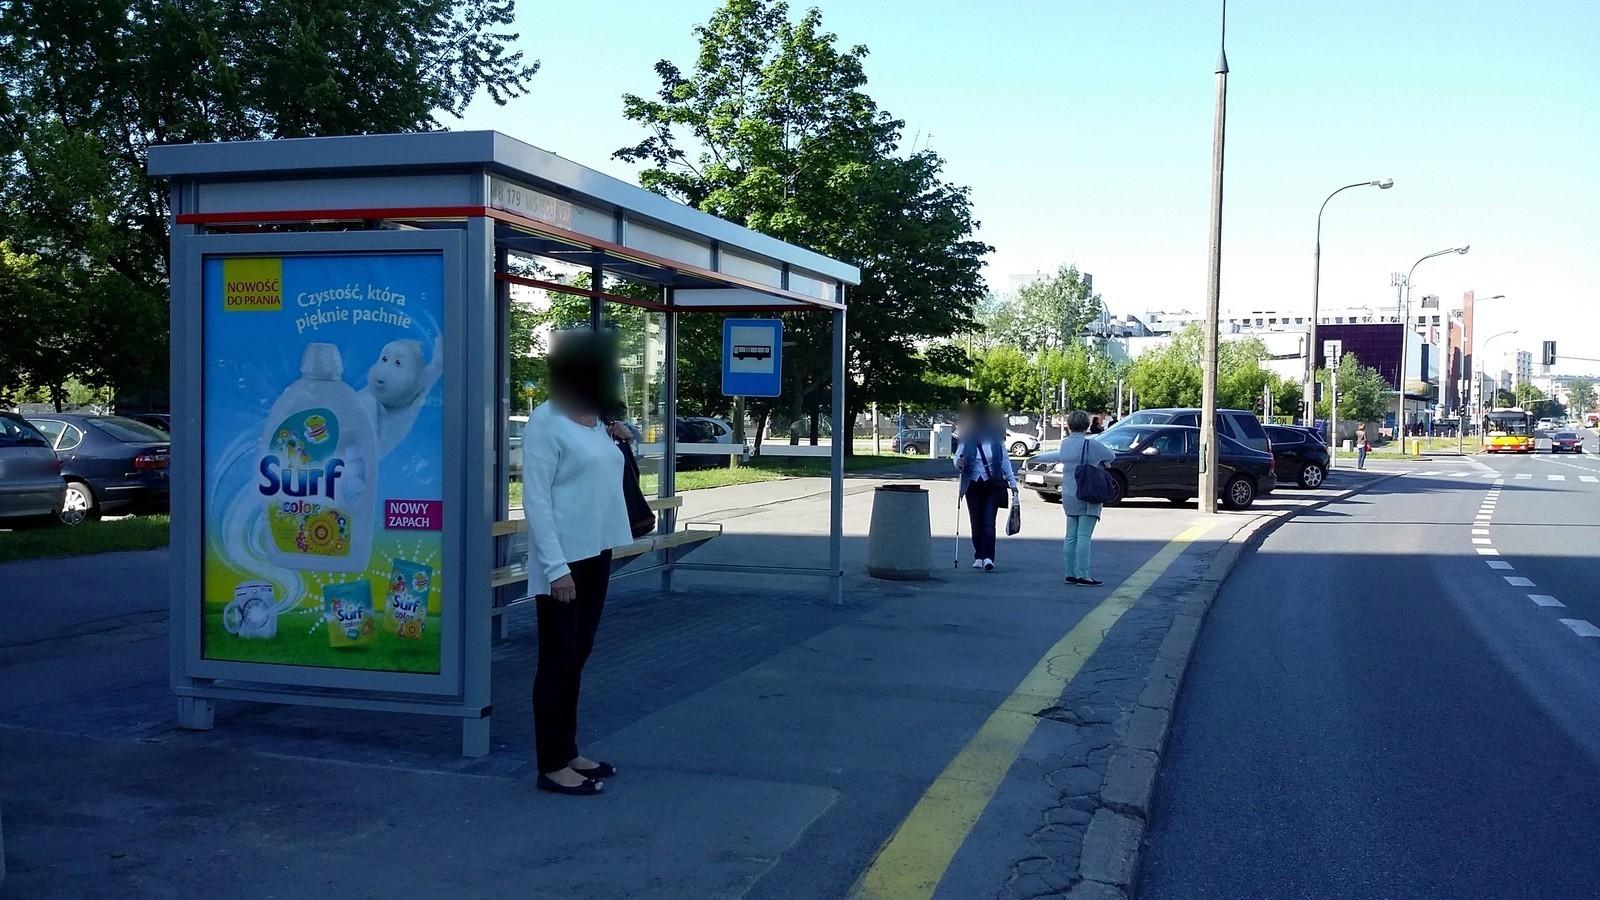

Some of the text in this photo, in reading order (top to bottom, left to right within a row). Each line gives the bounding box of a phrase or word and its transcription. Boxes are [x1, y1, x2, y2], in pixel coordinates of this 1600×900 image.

[507, 188, 521, 207] 179
[227, 278, 280, 293] NOWOŚĆ
[227, 295, 281, 306] DO PRANIA
[297, 283, 406, 307] Czystość, która
[295, 306, 412, 334] pięknie pachnie
[259, 455, 345, 499] Surf
[283, 500, 321, 514] color
[389, 502, 429, 515] NOWY
[389, 516, 430, 528] ZAPACH
[393, 595, 420, 613] Surf
[337, 606, 364, 621] Surf
